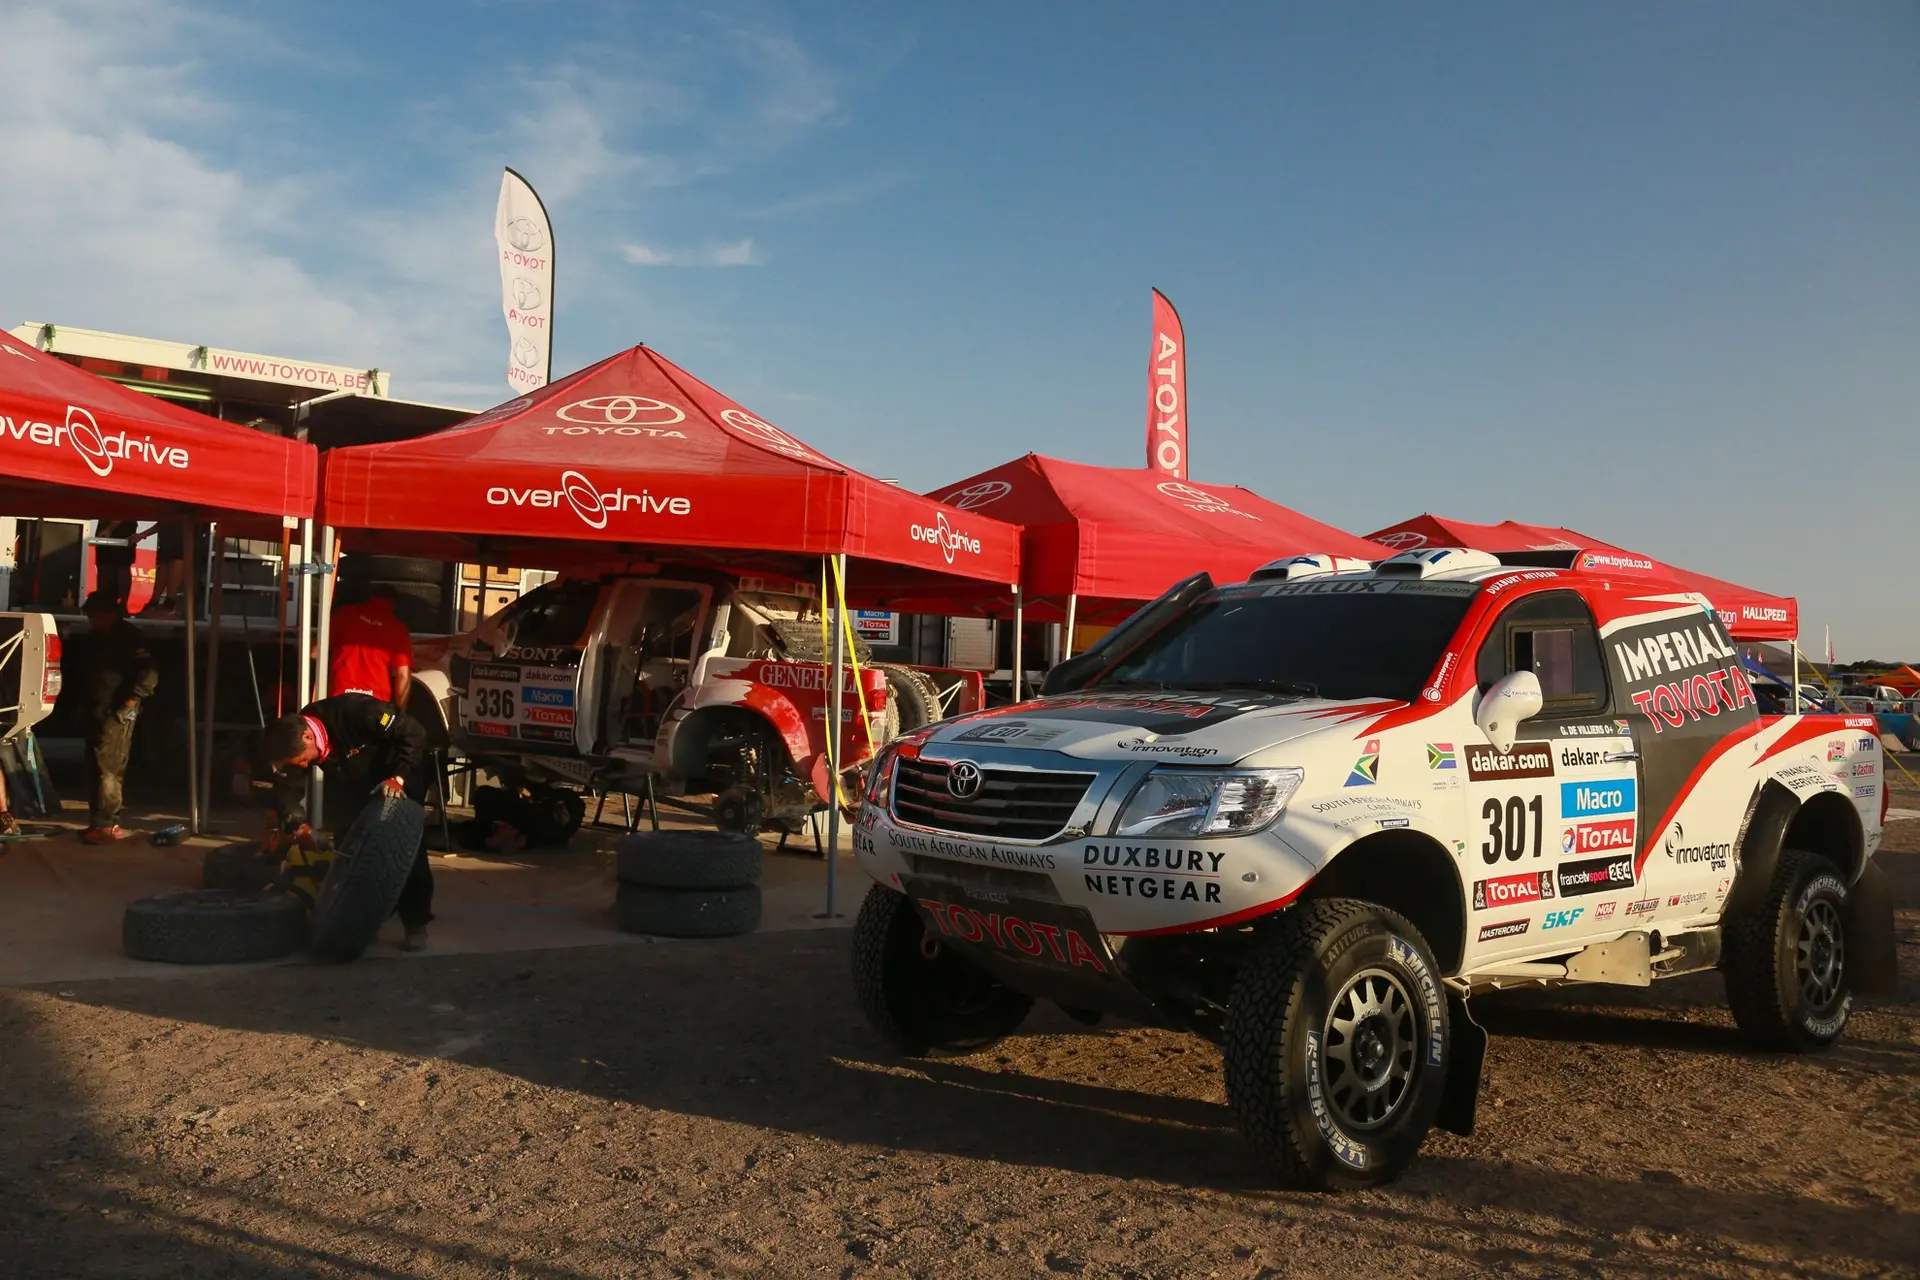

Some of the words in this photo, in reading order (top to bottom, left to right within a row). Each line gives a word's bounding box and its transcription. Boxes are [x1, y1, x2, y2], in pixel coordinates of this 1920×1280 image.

[213, 355, 367, 390] WWW.TOYOTA.BE
[0, 413, 66, 447] ver
[107, 431, 189, 469] drive
[542, 427, 688, 439] TOYOTA
[487, 487, 565, 508] over
[601, 487, 691, 515] drive
[911, 524, 941, 544] over
[950, 528, 981, 554] drive
[1593, 554, 1653, 569] www.toyota.co.za
[1274, 581, 1383, 595] HILUX
[1400, 583, 1472, 595] dakar.com
[1486, 575, 1522, 596] DUXBURY
[1522, 571, 1560, 580] NETGEAR
[506, 646, 564, 662] SONY
[1614, 623, 1736, 682] IMPERIAL
[473, 666, 518, 679] dakar.com
[526, 670, 572, 683] dakar.com
[760, 664, 858, 694] GENERLI
[475, 687, 514, 719] 336
[531, 689, 564, 703] Macro
[1631, 665, 1757, 733] TOYOTA
[535, 708, 572, 722] TOTAL
[479, 723, 508, 735] TOTAL
[989, 728, 1031, 738] 301
[1568, 725, 1578, 735] DE
[1578, 725, 1604, 735] VILLIERS
[1131, 745, 1218, 756] innovation
[1858, 738, 1874, 751] TFM
[1471, 751, 1549, 773] dakar.com
[1562, 747, 1608, 767] dakar.c
[1776, 764, 1817, 780] FINANCIAL
[1856, 763, 1874, 776] Castrol
[1788, 775, 1826, 790] SERVICES
[1311, 797, 1349, 814] SOUTH
[1576, 787, 1622, 811] Macro
[1340, 816, 1363, 827] STAR
[1482, 794, 1543, 865] 301
[1579, 825, 1632, 849] TOTAL
[888, 829, 927, 851] SOUTH
[931, 836, 986, 860] AFRICAN
[990, 844, 1056, 870] AIRWAYS
[1084, 845, 1226, 873] DUXBURY
[1676, 842, 1731, 865] innovation
[1711, 859, 1727, 871] group
[1084, 874, 1222, 904] NETGEAR
[1488, 881, 1538, 901] TOTAL
[1807, 877, 1847, 899] MICHELIN
[1680, 892, 1707, 905] edgecam
[1541, 908, 1584, 930] SKF
[1596, 903, 1615, 916] NGK
[919, 898, 1107, 972] TOYOTA
[1480, 923, 1529, 939] MASTERCRAFT
[1322, 923, 1370, 970] LATITUDE
[1406, 952, 1442, 1063] MICHELIN
